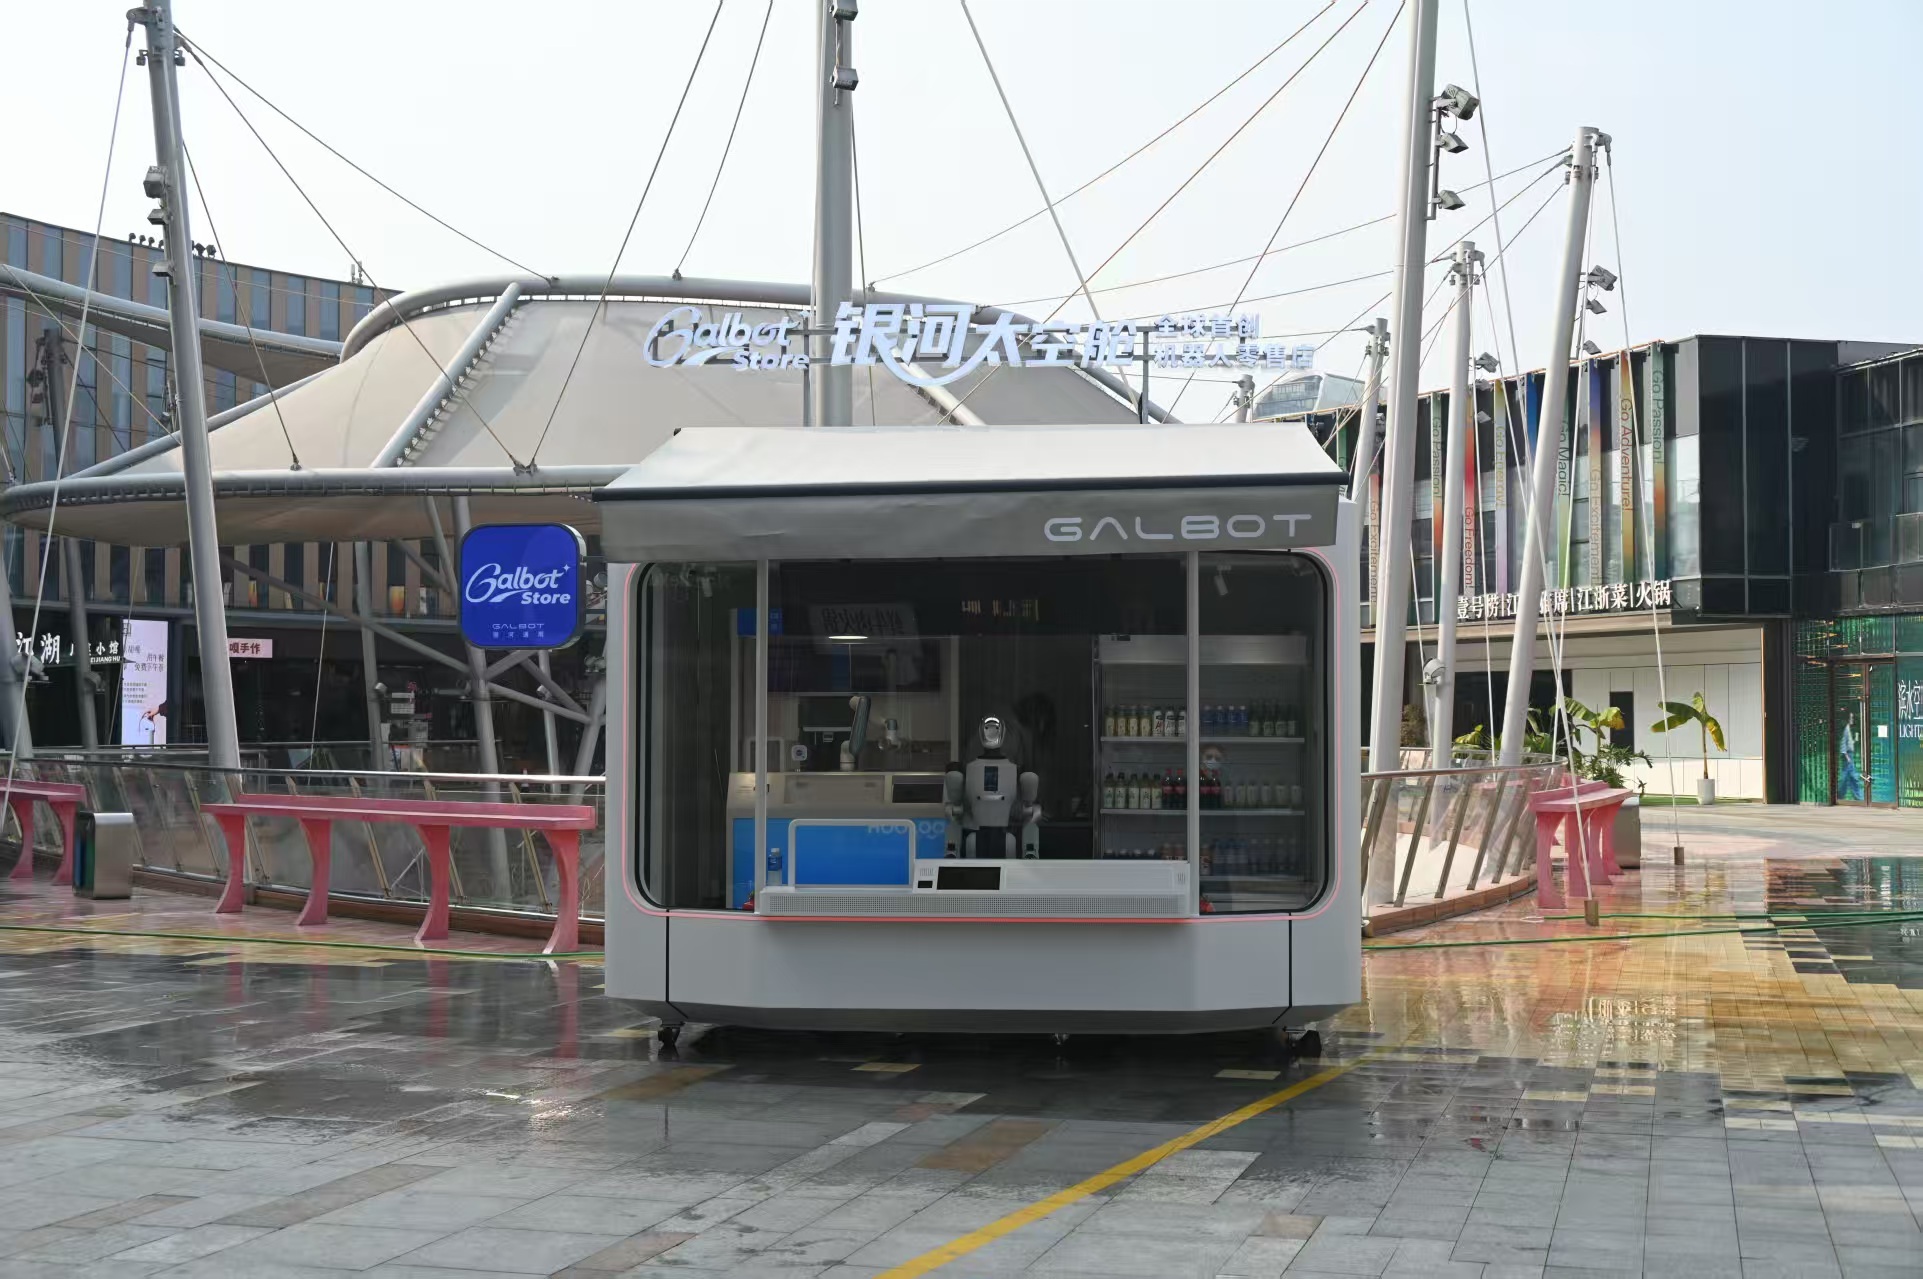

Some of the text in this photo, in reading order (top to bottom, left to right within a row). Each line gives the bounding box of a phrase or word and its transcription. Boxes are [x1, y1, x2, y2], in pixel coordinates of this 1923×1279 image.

[643, 306, 802, 367] Galbot
[831, 301, 1137, 387] 银河太空舱
[1155, 313, 1263, 339] 全球首创
[731, 348, 811, 370] Store
[1154, 343, 1317, 369] 机器人零售店
[1652, 370, 1664, 464] Go Passion!
[1432, 439, 1441, 498] Passion!
[1621, 397, 1633, 511] Go Adventure!
[1044, 513, 1313, 542] GALBOT
[1464, 506, 1474, 589] Go Freedom!
[465, 562, 564, 603] Galbot
[521, 591, 571, 605] Store
[15, 631, 61, 664] 江湖
